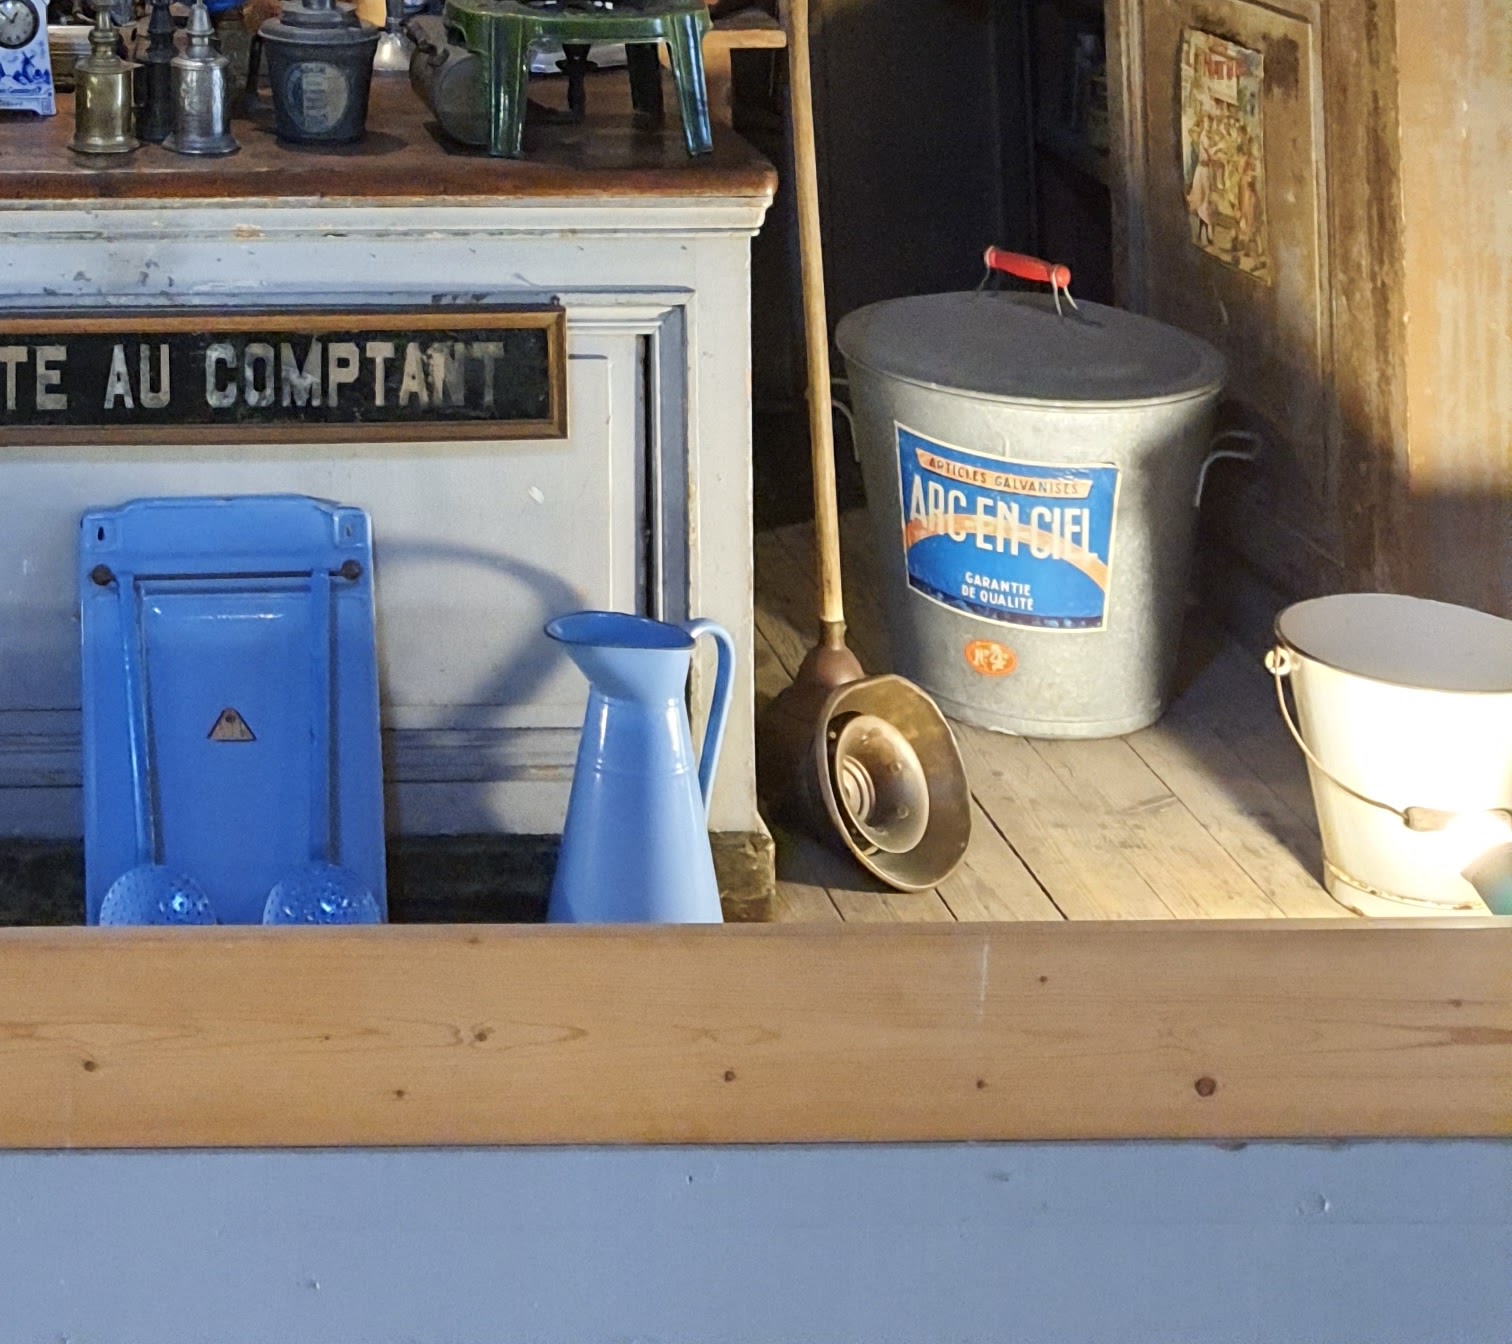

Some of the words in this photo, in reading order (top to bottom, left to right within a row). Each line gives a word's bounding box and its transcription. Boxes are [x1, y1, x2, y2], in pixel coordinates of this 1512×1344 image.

[103, 341, 172, 410] AU
[204, 340, 506, 411] COMPTANT
[928, 457, 988, 485] ARTICLES
[961, 583, 976, 600] DE
[964, 570, 1032, 597] GARANTIE
